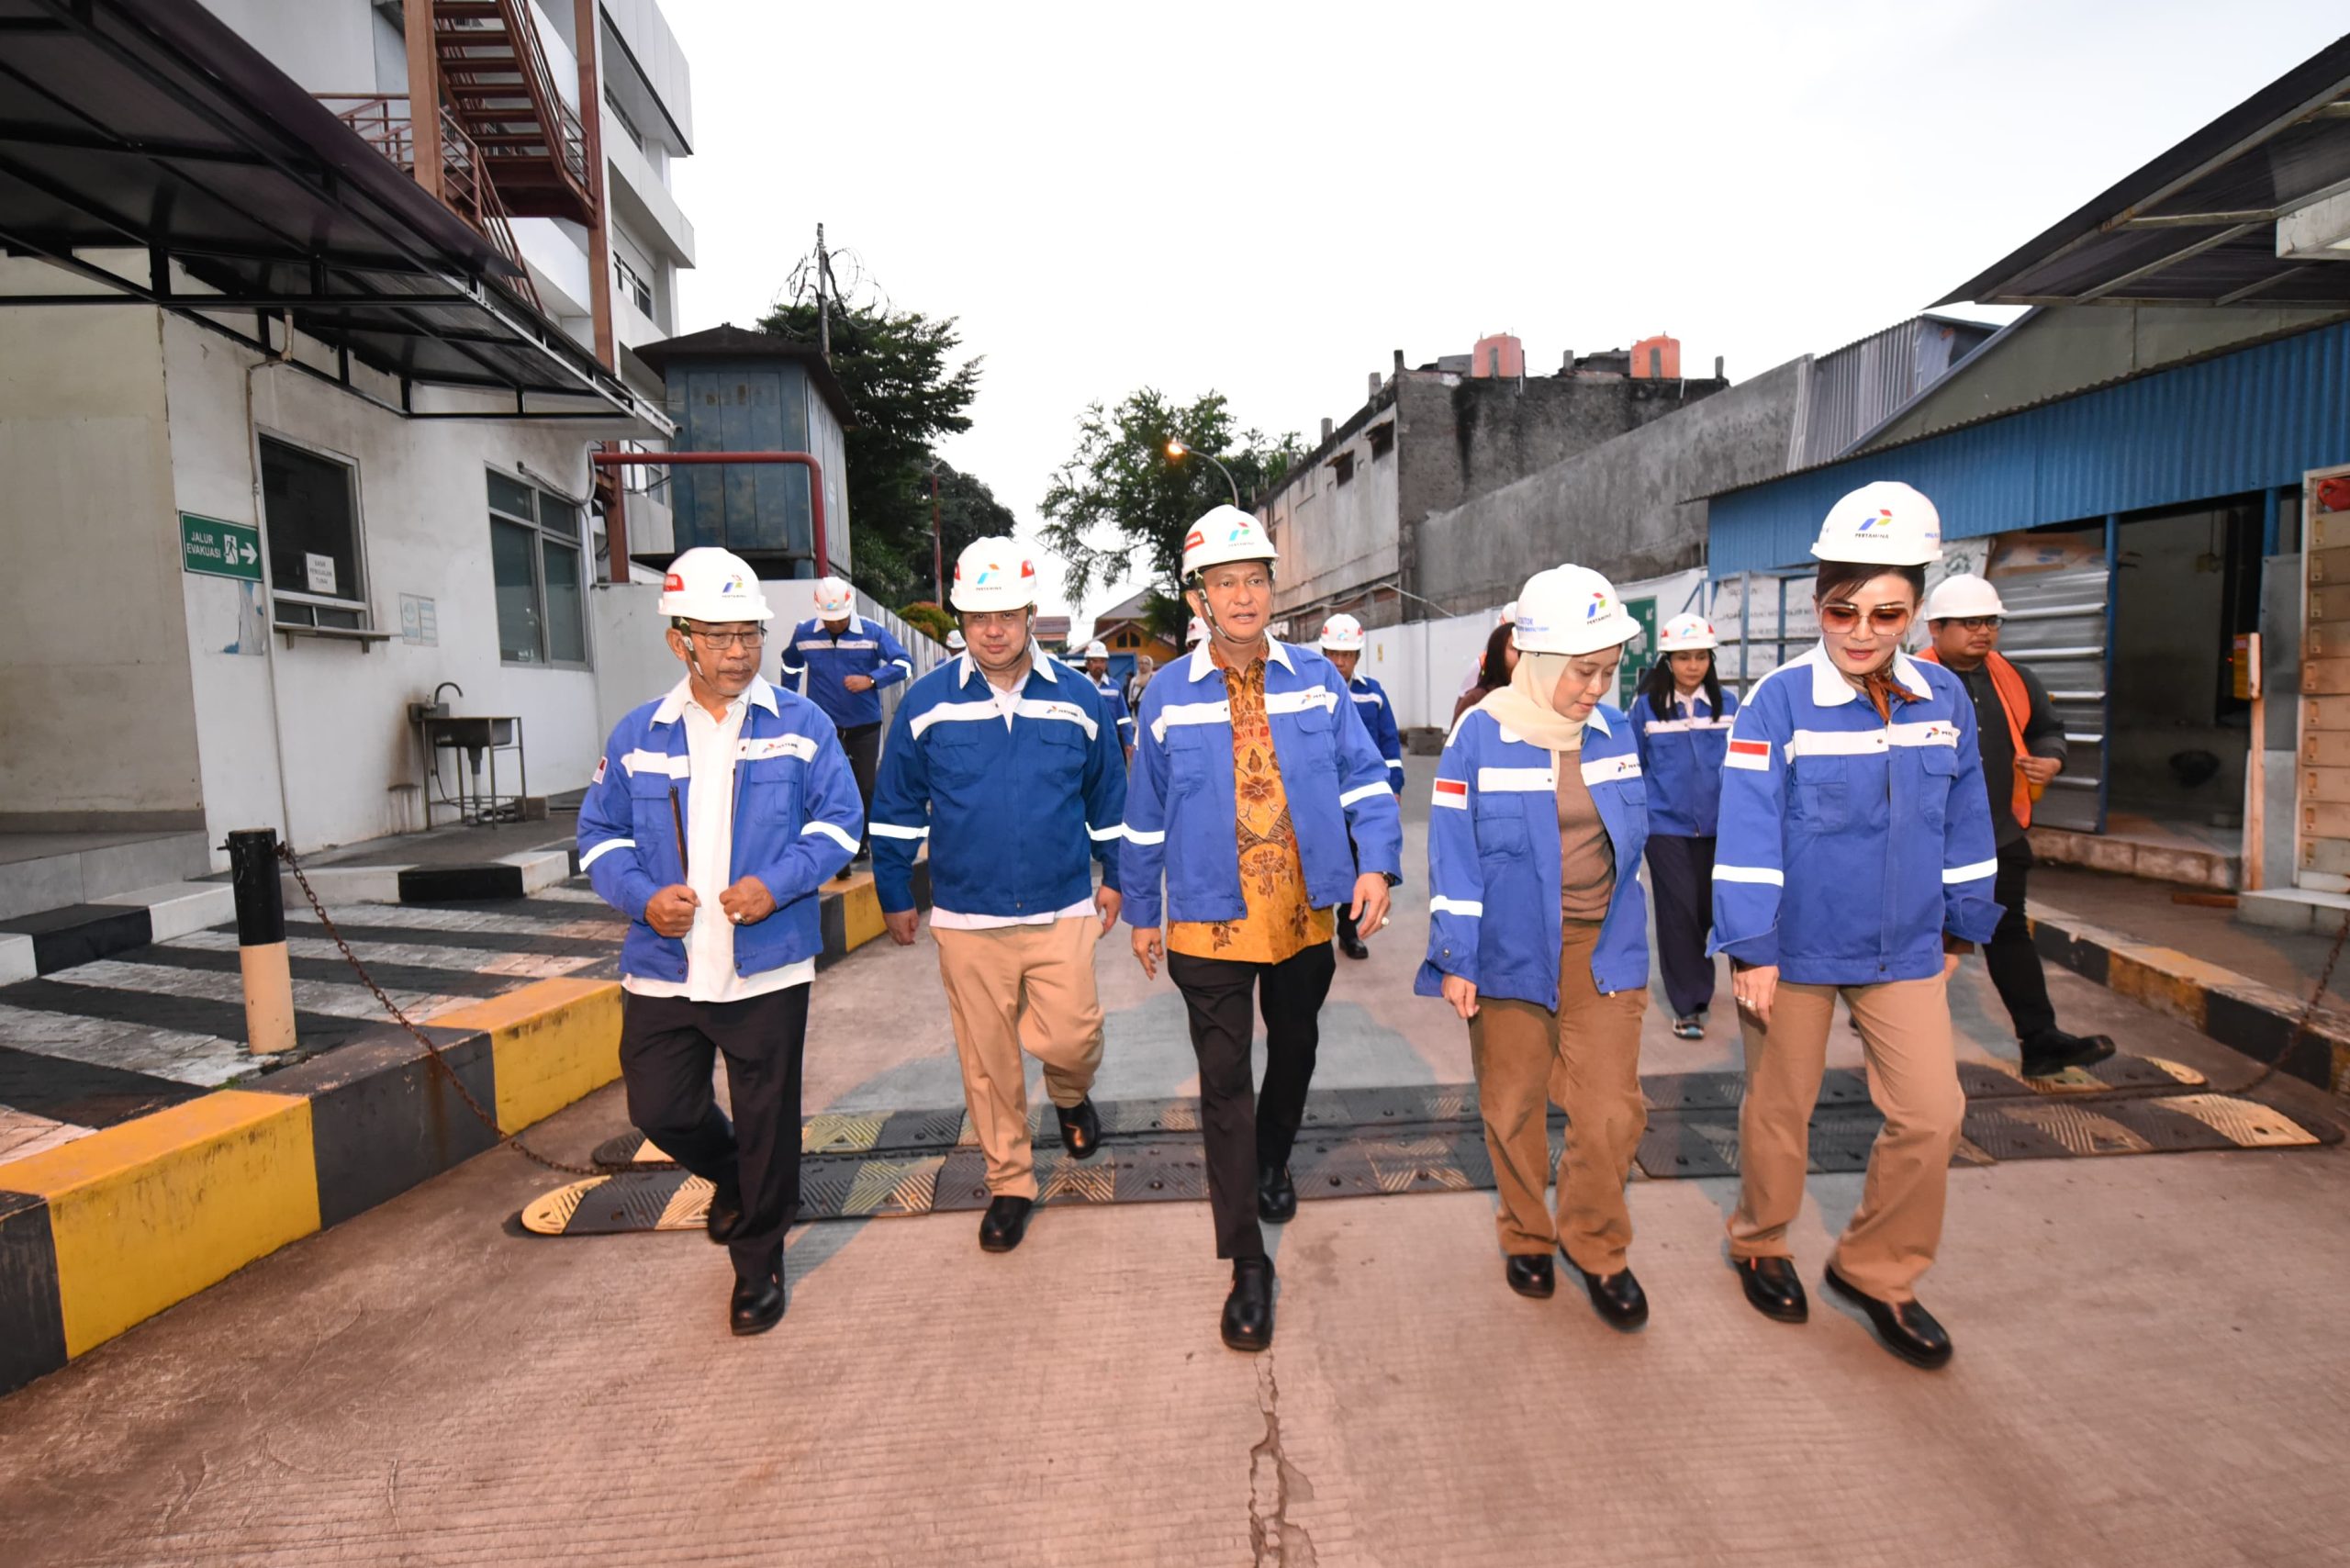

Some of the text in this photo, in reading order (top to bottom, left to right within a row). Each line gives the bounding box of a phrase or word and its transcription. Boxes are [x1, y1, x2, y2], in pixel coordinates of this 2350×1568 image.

[191, 532, 214, 544] JALUR
[186, 543, 221, 558] EVAKUASI
[1586, 612, 1612, 625] PERTAMINA
